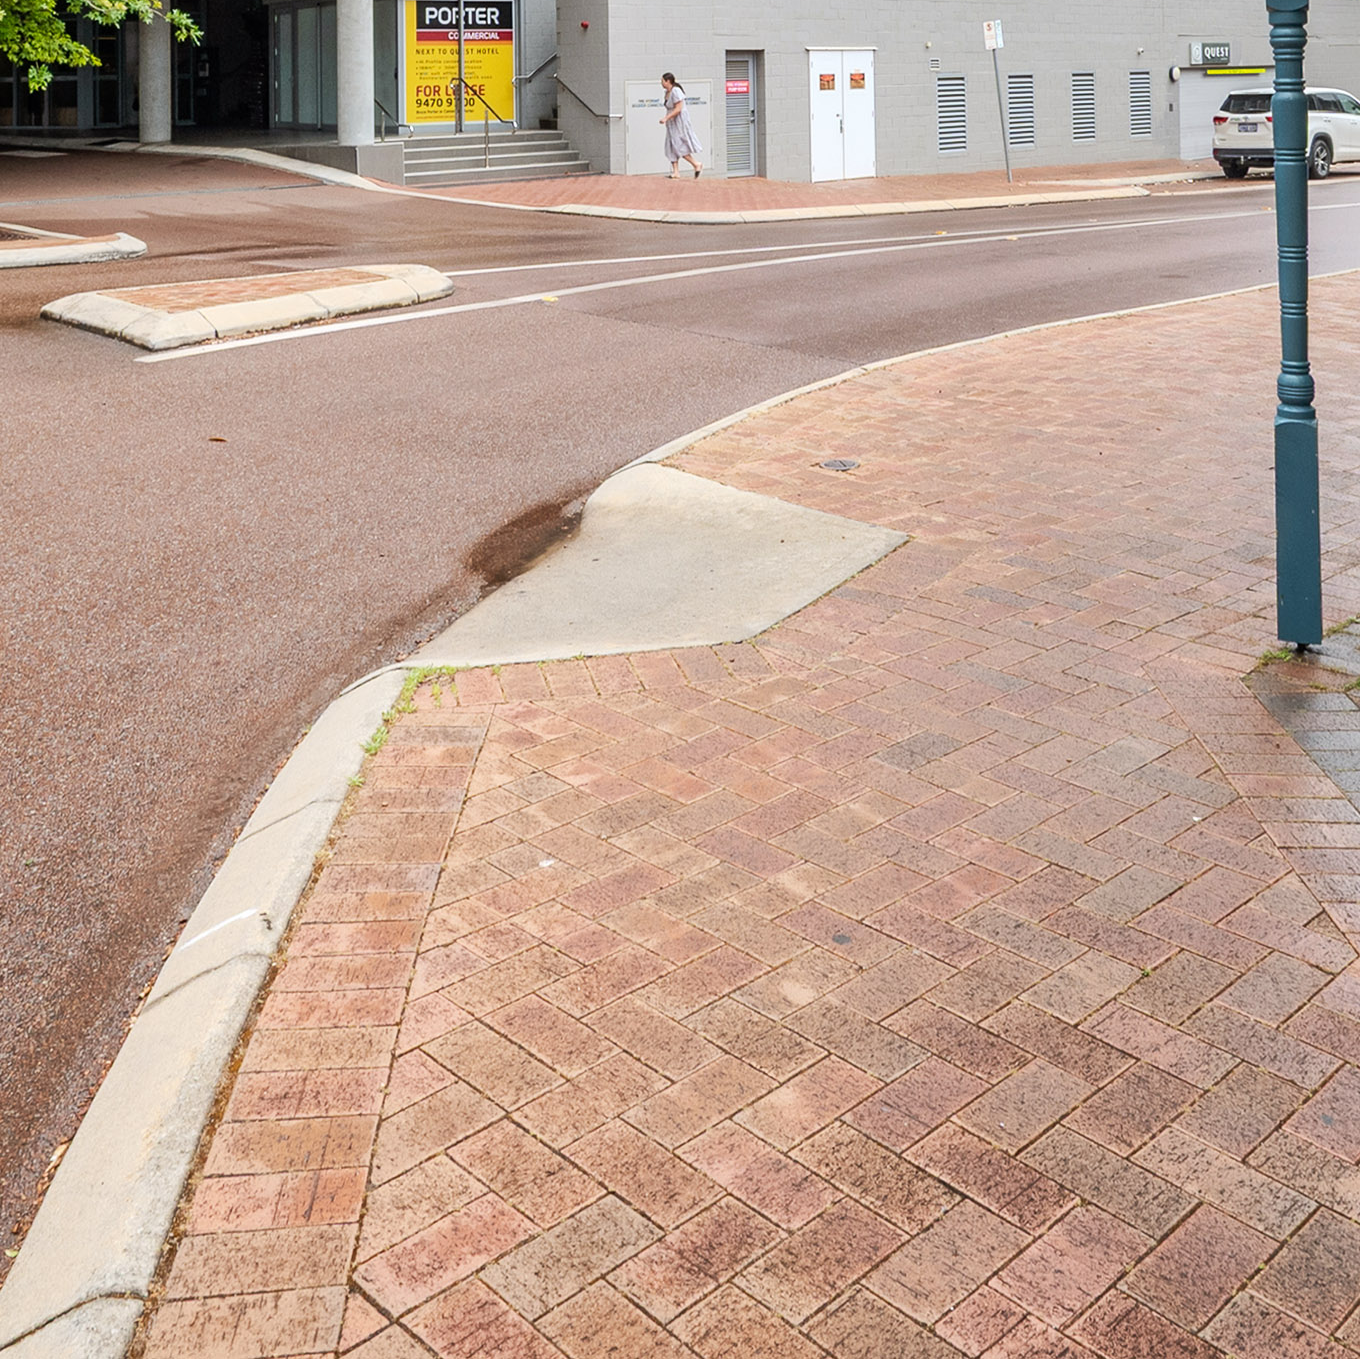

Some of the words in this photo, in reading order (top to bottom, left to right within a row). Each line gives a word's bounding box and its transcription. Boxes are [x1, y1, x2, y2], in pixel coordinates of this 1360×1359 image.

[425, 6, 500, 25] PORTER
[1204, 46, 1229, 59] QUEST
[416, 85, 441, 97] FOR
[415, 97, 443, 108] 9470
[445, 97, 475, 108] 900
